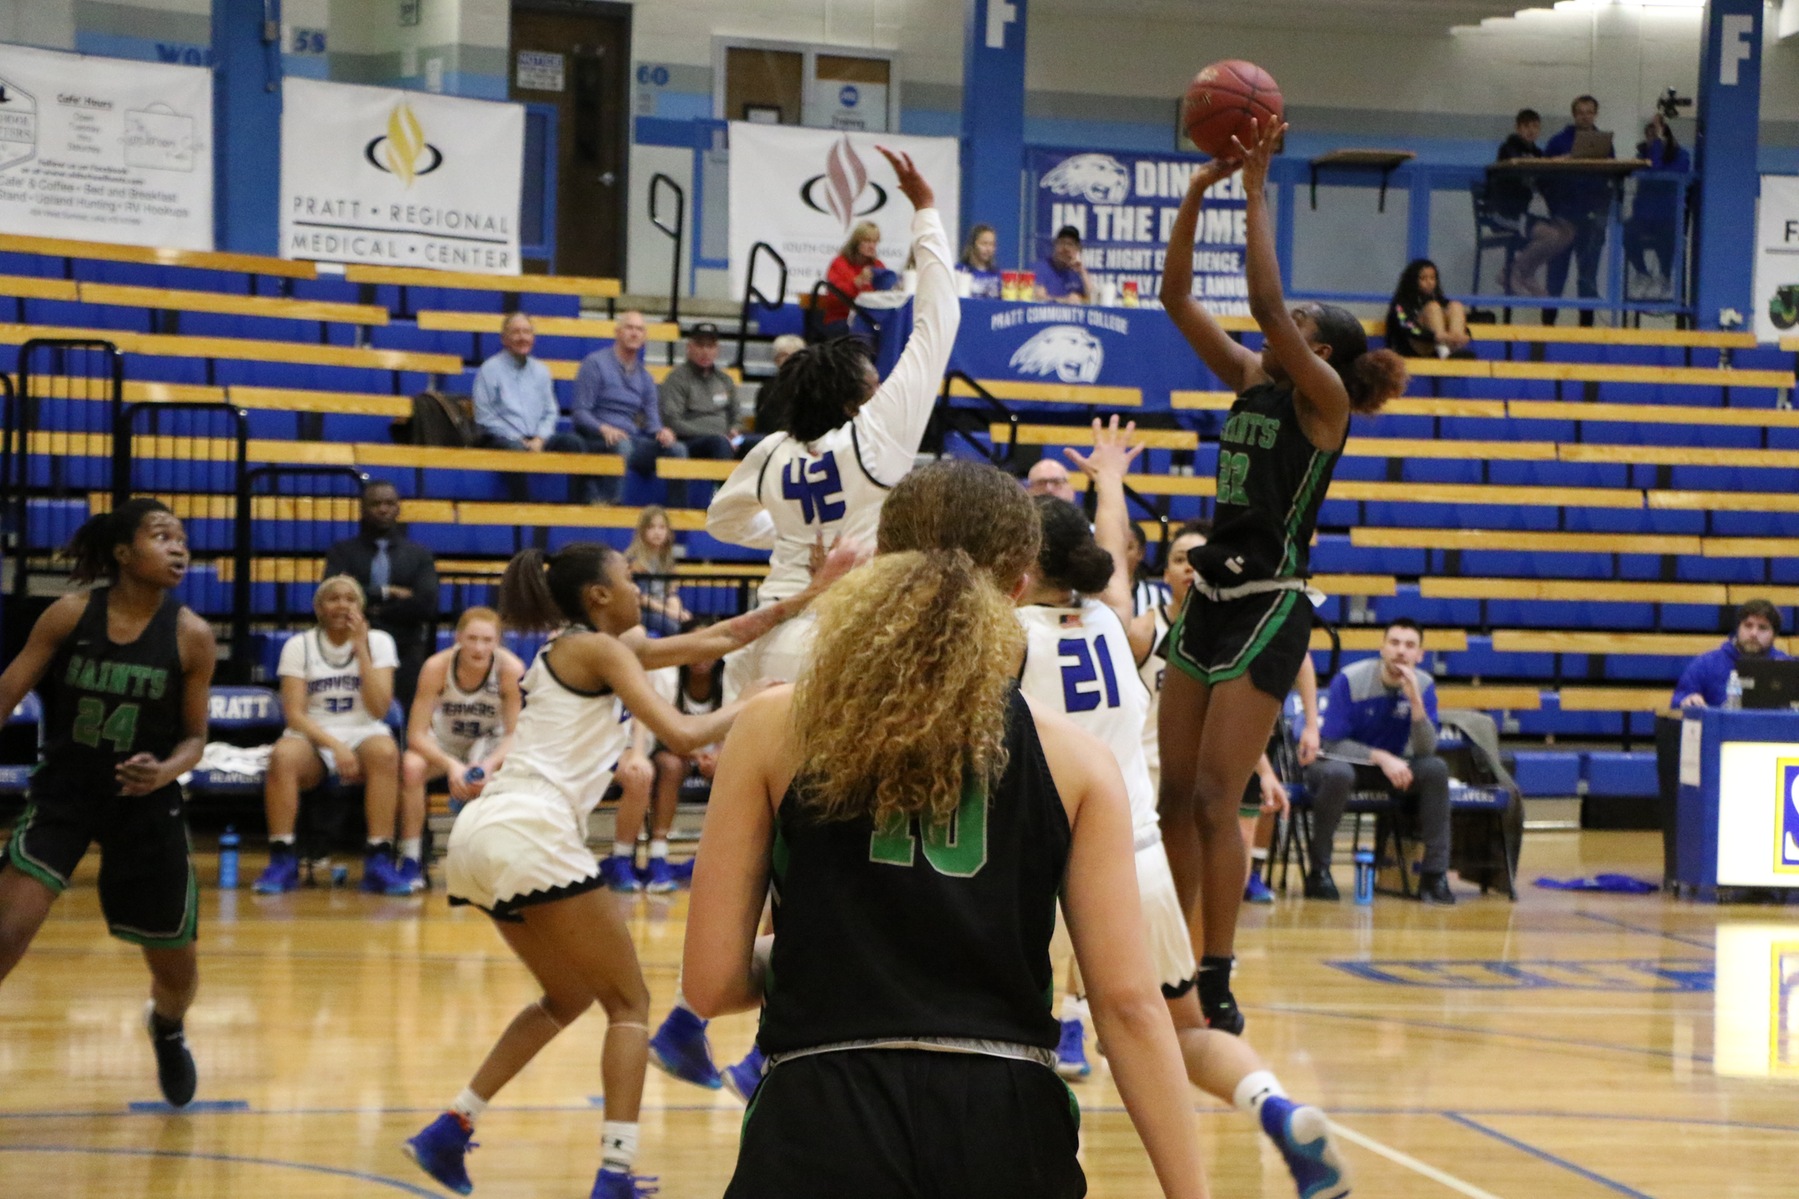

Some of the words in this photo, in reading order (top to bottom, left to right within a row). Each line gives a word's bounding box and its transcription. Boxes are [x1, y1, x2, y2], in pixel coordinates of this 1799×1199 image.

[1719, 14, 1754, 86] F
[636, 65, 669, 87] 60
[1135, 161, 1248, 200] DINER
[293, 196, 360, 219] PRATT
[390, 204, 508, 234] REGIONAL
[1051, 203, 1087, 241] IN
[1093, 205, 1154, 242] THE
[291, 233, 396, 259] MEDICAL
[425, 242, 509, 268] CENTER
[1106, 248, 1153, 271] NIGHT
[781, 450, 847, 526] 42
[65, 655, 169, 700] SAINTS
[307, 675, 362, 693] BEAVER
[1058, 634, 1121, 714] 21
[72, 697, 139, 753] 24
[208, 694, 270, 719] RATT
